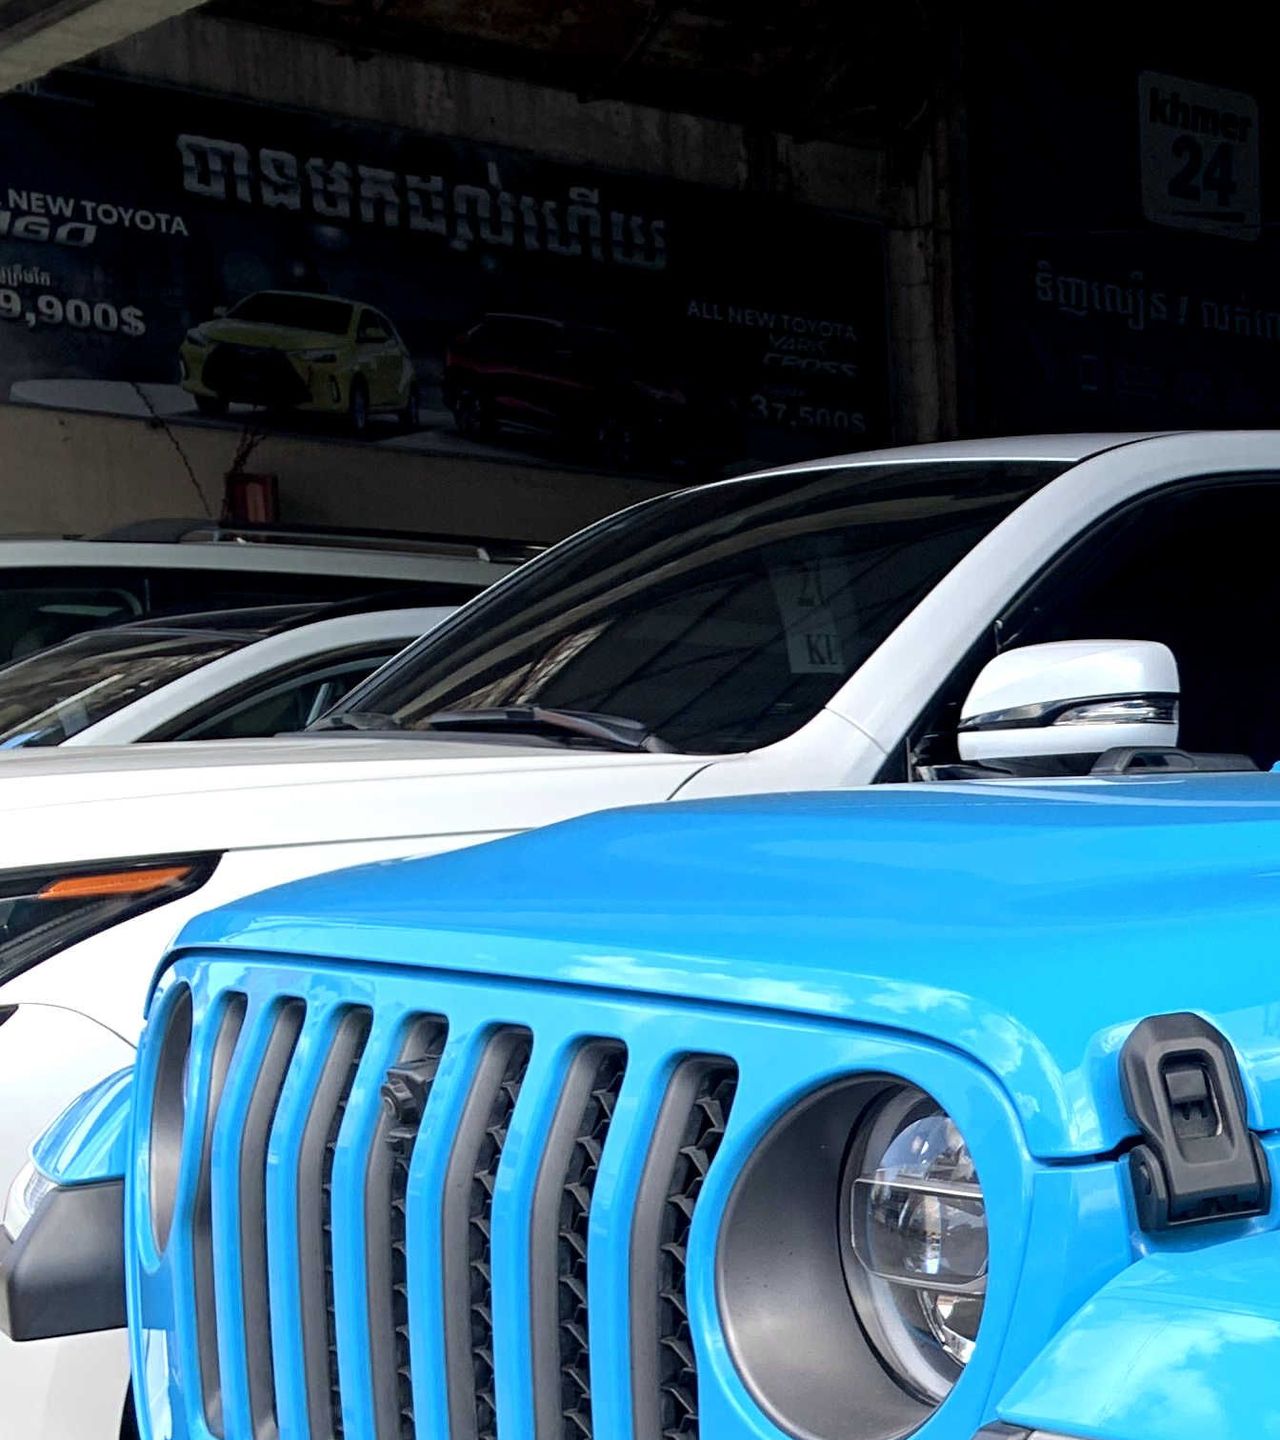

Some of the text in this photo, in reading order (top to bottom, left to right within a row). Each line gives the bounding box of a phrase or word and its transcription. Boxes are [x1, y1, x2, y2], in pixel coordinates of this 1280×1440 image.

[1168, 134, 1237, 206] 24
[7, 187, 191, 237] NEW TOYOTA
[0, 288, 147, 338] 9,900$
[687, 298, 859, 345] ALL NEW TOYOTA
